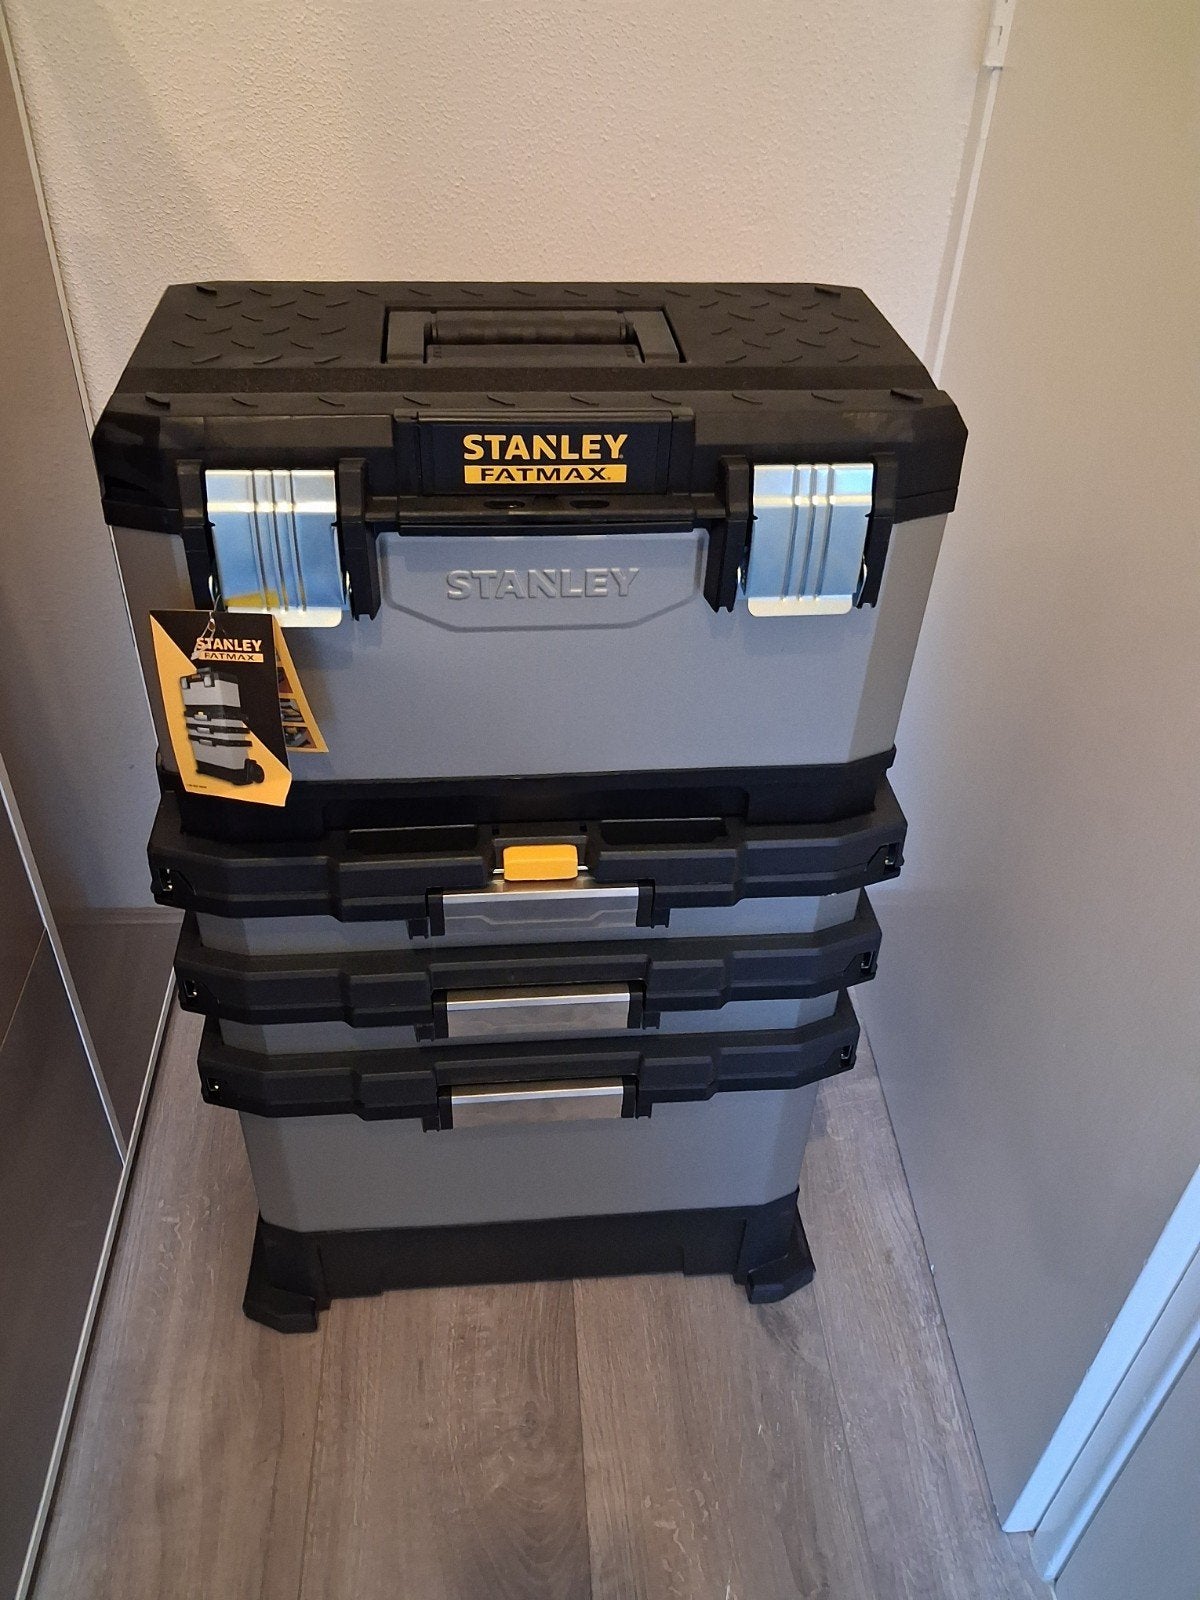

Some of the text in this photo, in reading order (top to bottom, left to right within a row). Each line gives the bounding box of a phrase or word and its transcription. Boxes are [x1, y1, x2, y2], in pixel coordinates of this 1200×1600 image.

[463, 434, 628, 460] STANLEY
[481, 467, 609, 482] FATMAX
[446, 567, 639, 600] STANLEY
[196, 637, 262, 652] STANLEY
[204, 652, 255, 661] FATMAX
